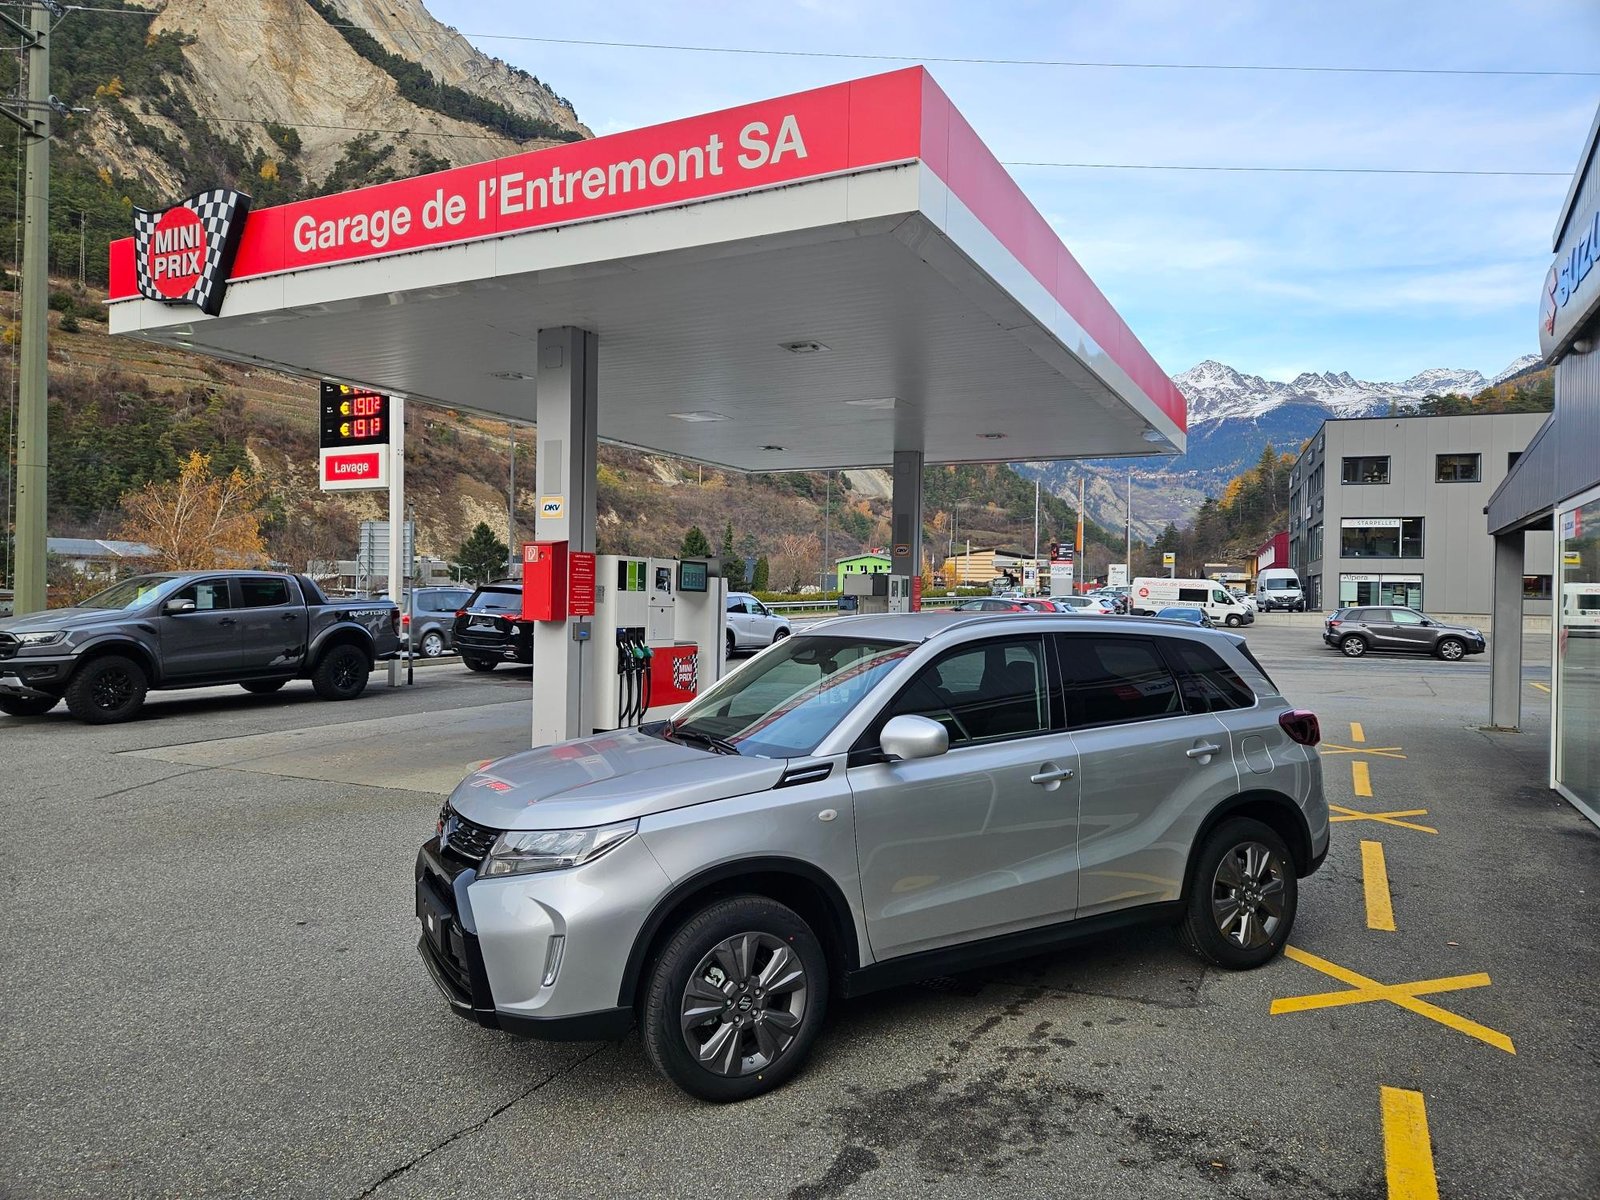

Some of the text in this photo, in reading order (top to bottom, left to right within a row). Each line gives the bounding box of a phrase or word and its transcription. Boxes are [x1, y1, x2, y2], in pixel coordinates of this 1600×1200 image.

[293, 114, 808, 253] Garage de l'Entremont SA
[154, 224, 201, 252] MINI
[154, 251, 201, 280] PRIX
[335, 462, 369, 474] Lavage
[544, 503, 560, 511] DKV
[1179, 581, 1204, 589] location
[680, 665, 692, 673] MINI
[679, 673, 692, 682] PRIX
